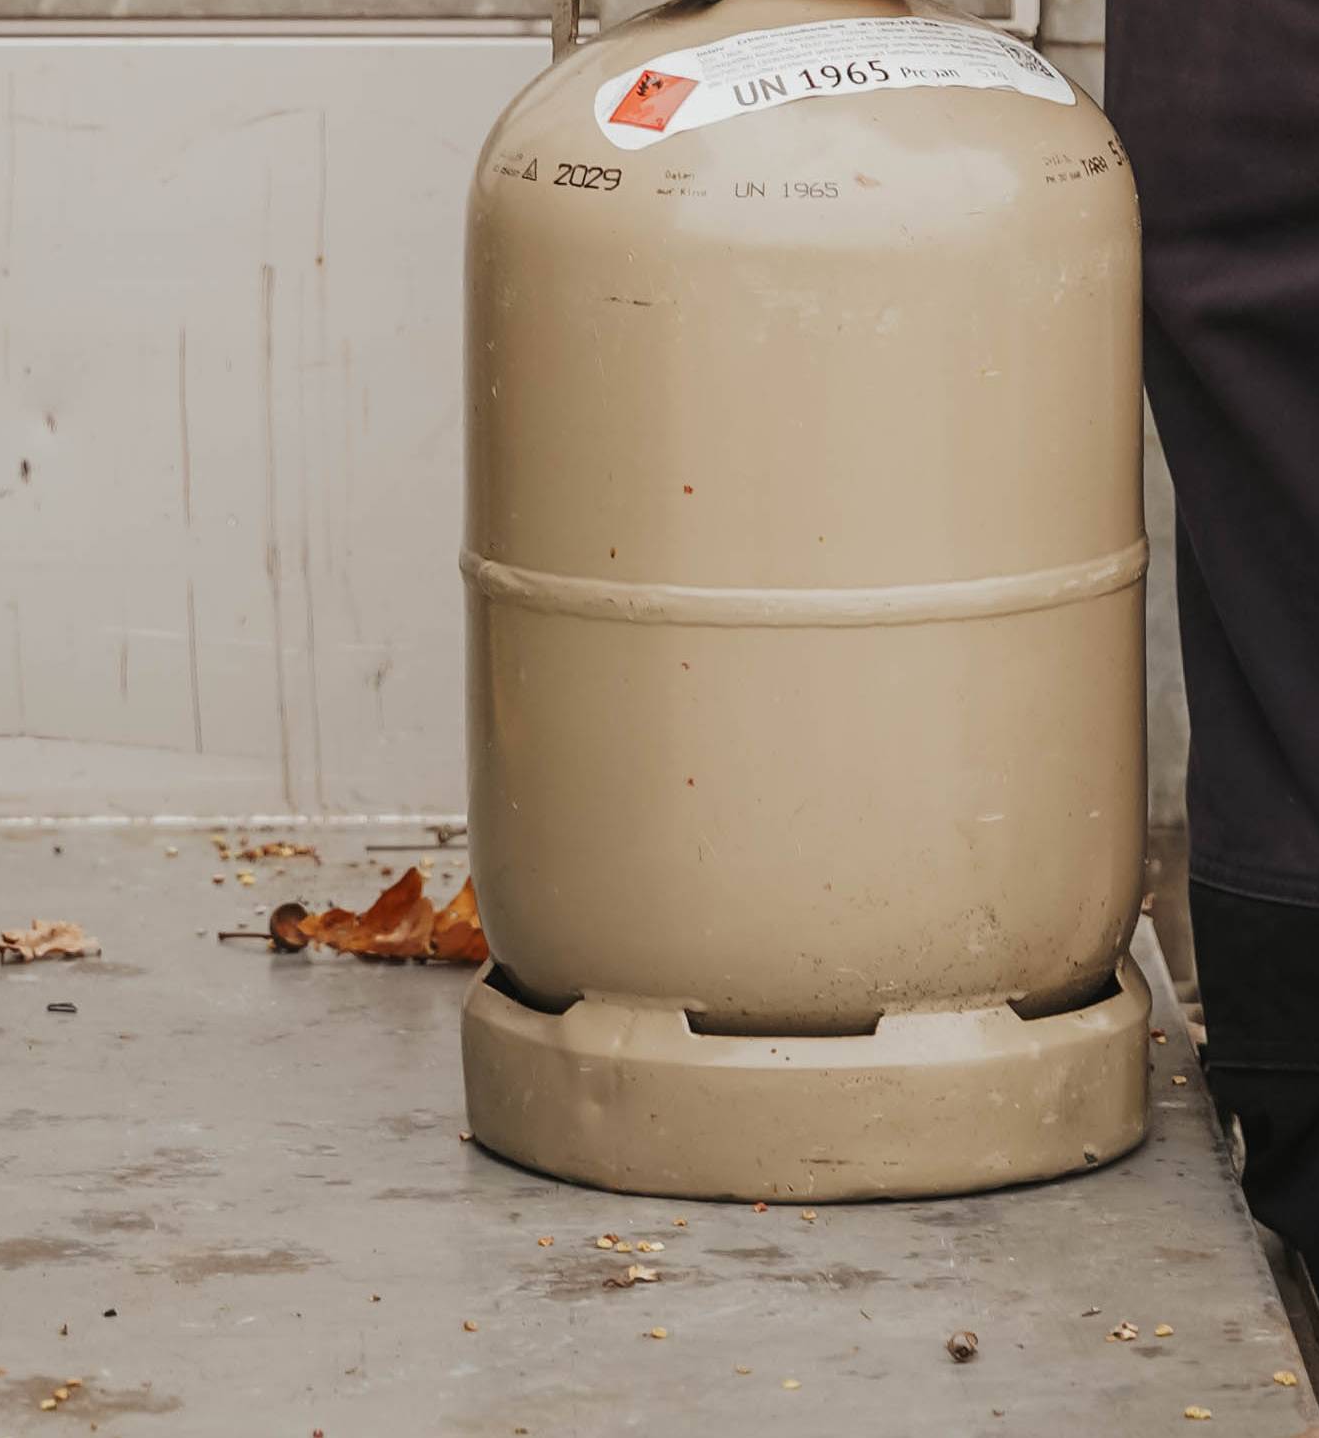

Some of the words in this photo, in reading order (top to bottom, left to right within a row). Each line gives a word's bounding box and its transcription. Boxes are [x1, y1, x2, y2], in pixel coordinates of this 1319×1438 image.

[733, 74, 788, 107] UN
[798, 59, 890, 91] 1965
[553, 162, 623, 191] 2029
[735, 181, 766, 199] UN
[782, 181, 839, 199] 1965
